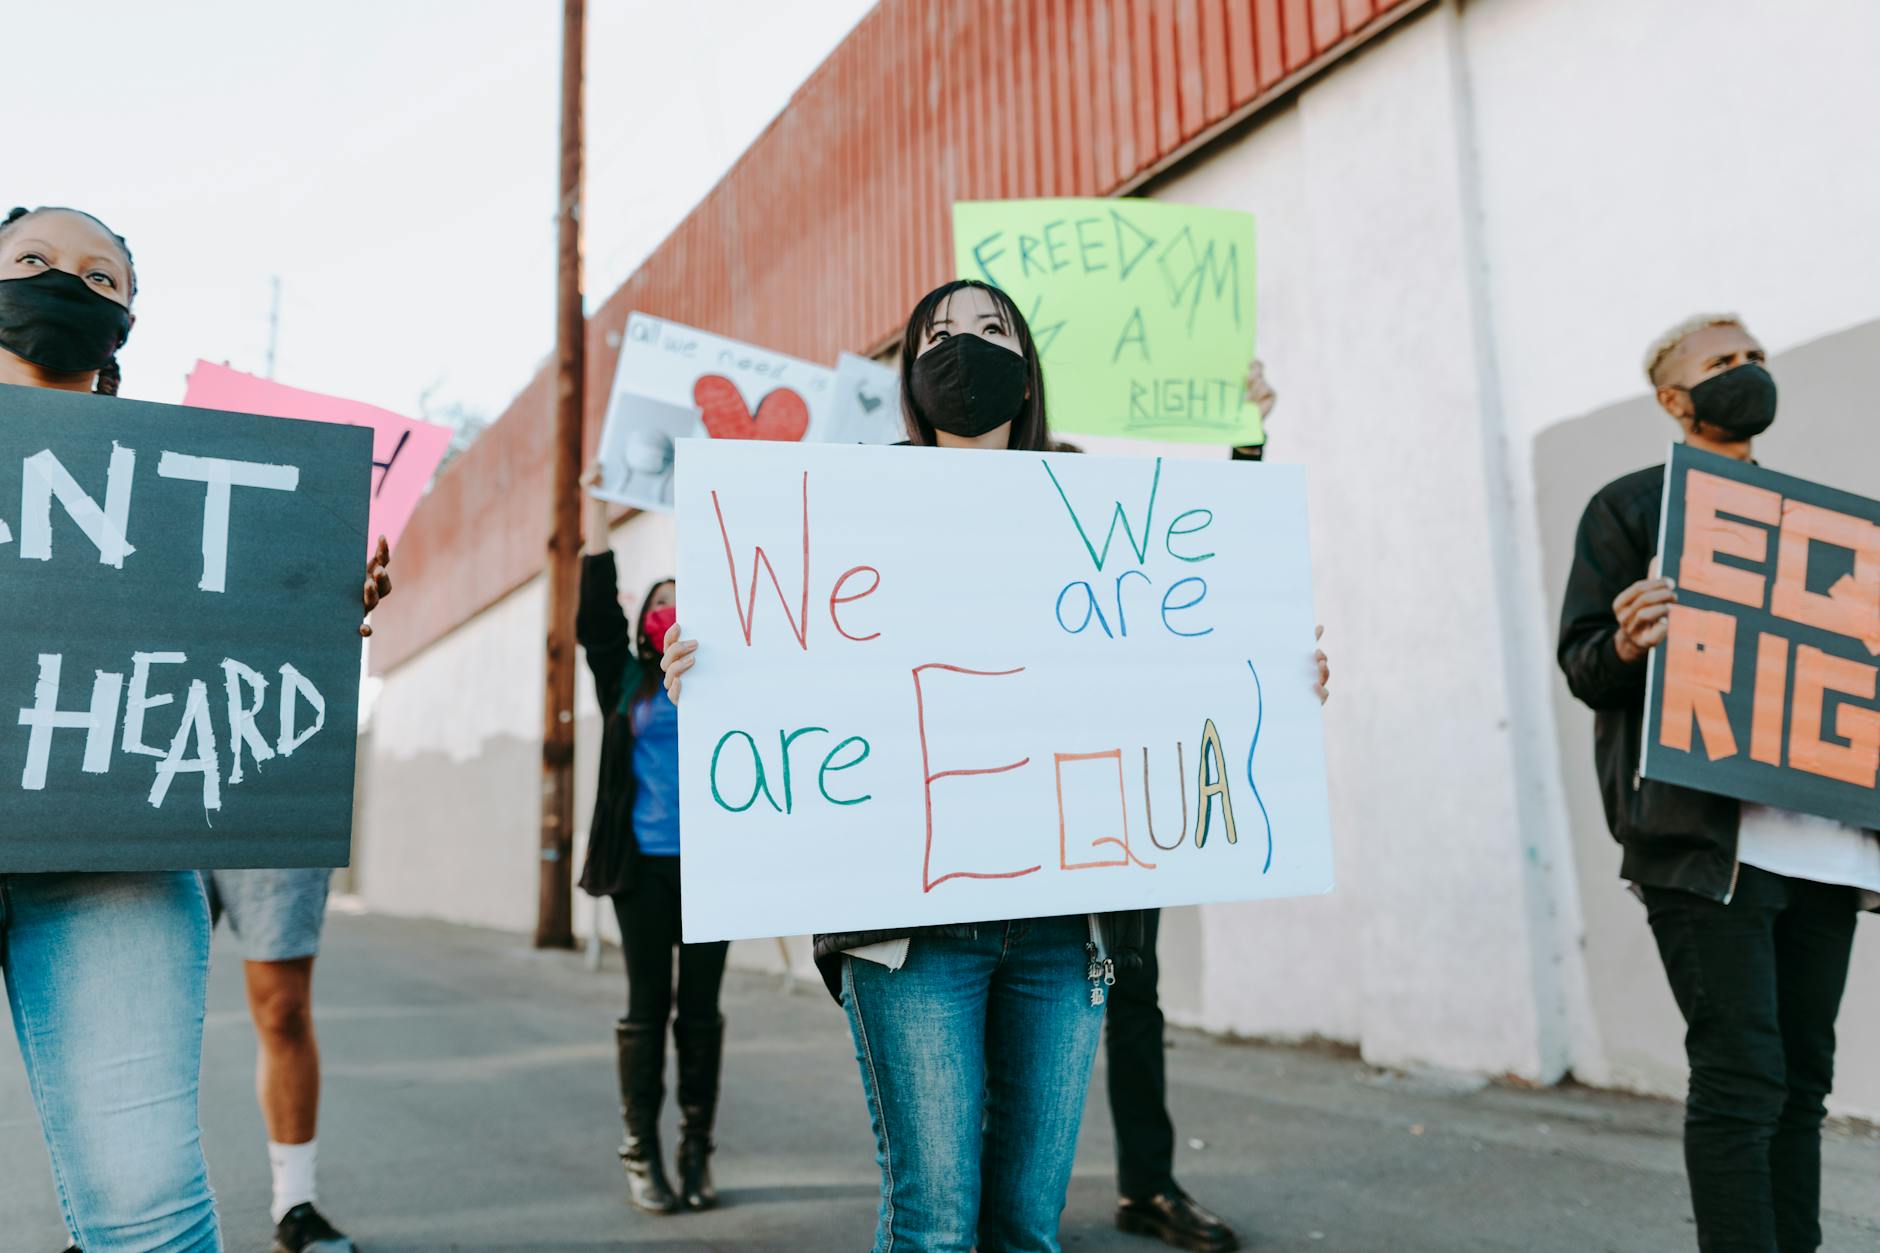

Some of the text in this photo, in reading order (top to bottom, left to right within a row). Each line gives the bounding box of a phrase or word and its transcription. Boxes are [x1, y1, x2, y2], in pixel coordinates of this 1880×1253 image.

[973, 208, 1242, 338] FREEDOM
[716, 348, 788, 379] need
[1112, 306, 1152, 365] A
[711, 471, 882, 650] We
[1042, 456, 1216, 571] We
[1055, 570, 1215, 639] are
[18, 651, 325, 813] HEARD
[1659, 603, 1880, 789] RIG
[710, 727, 872, 815] are
